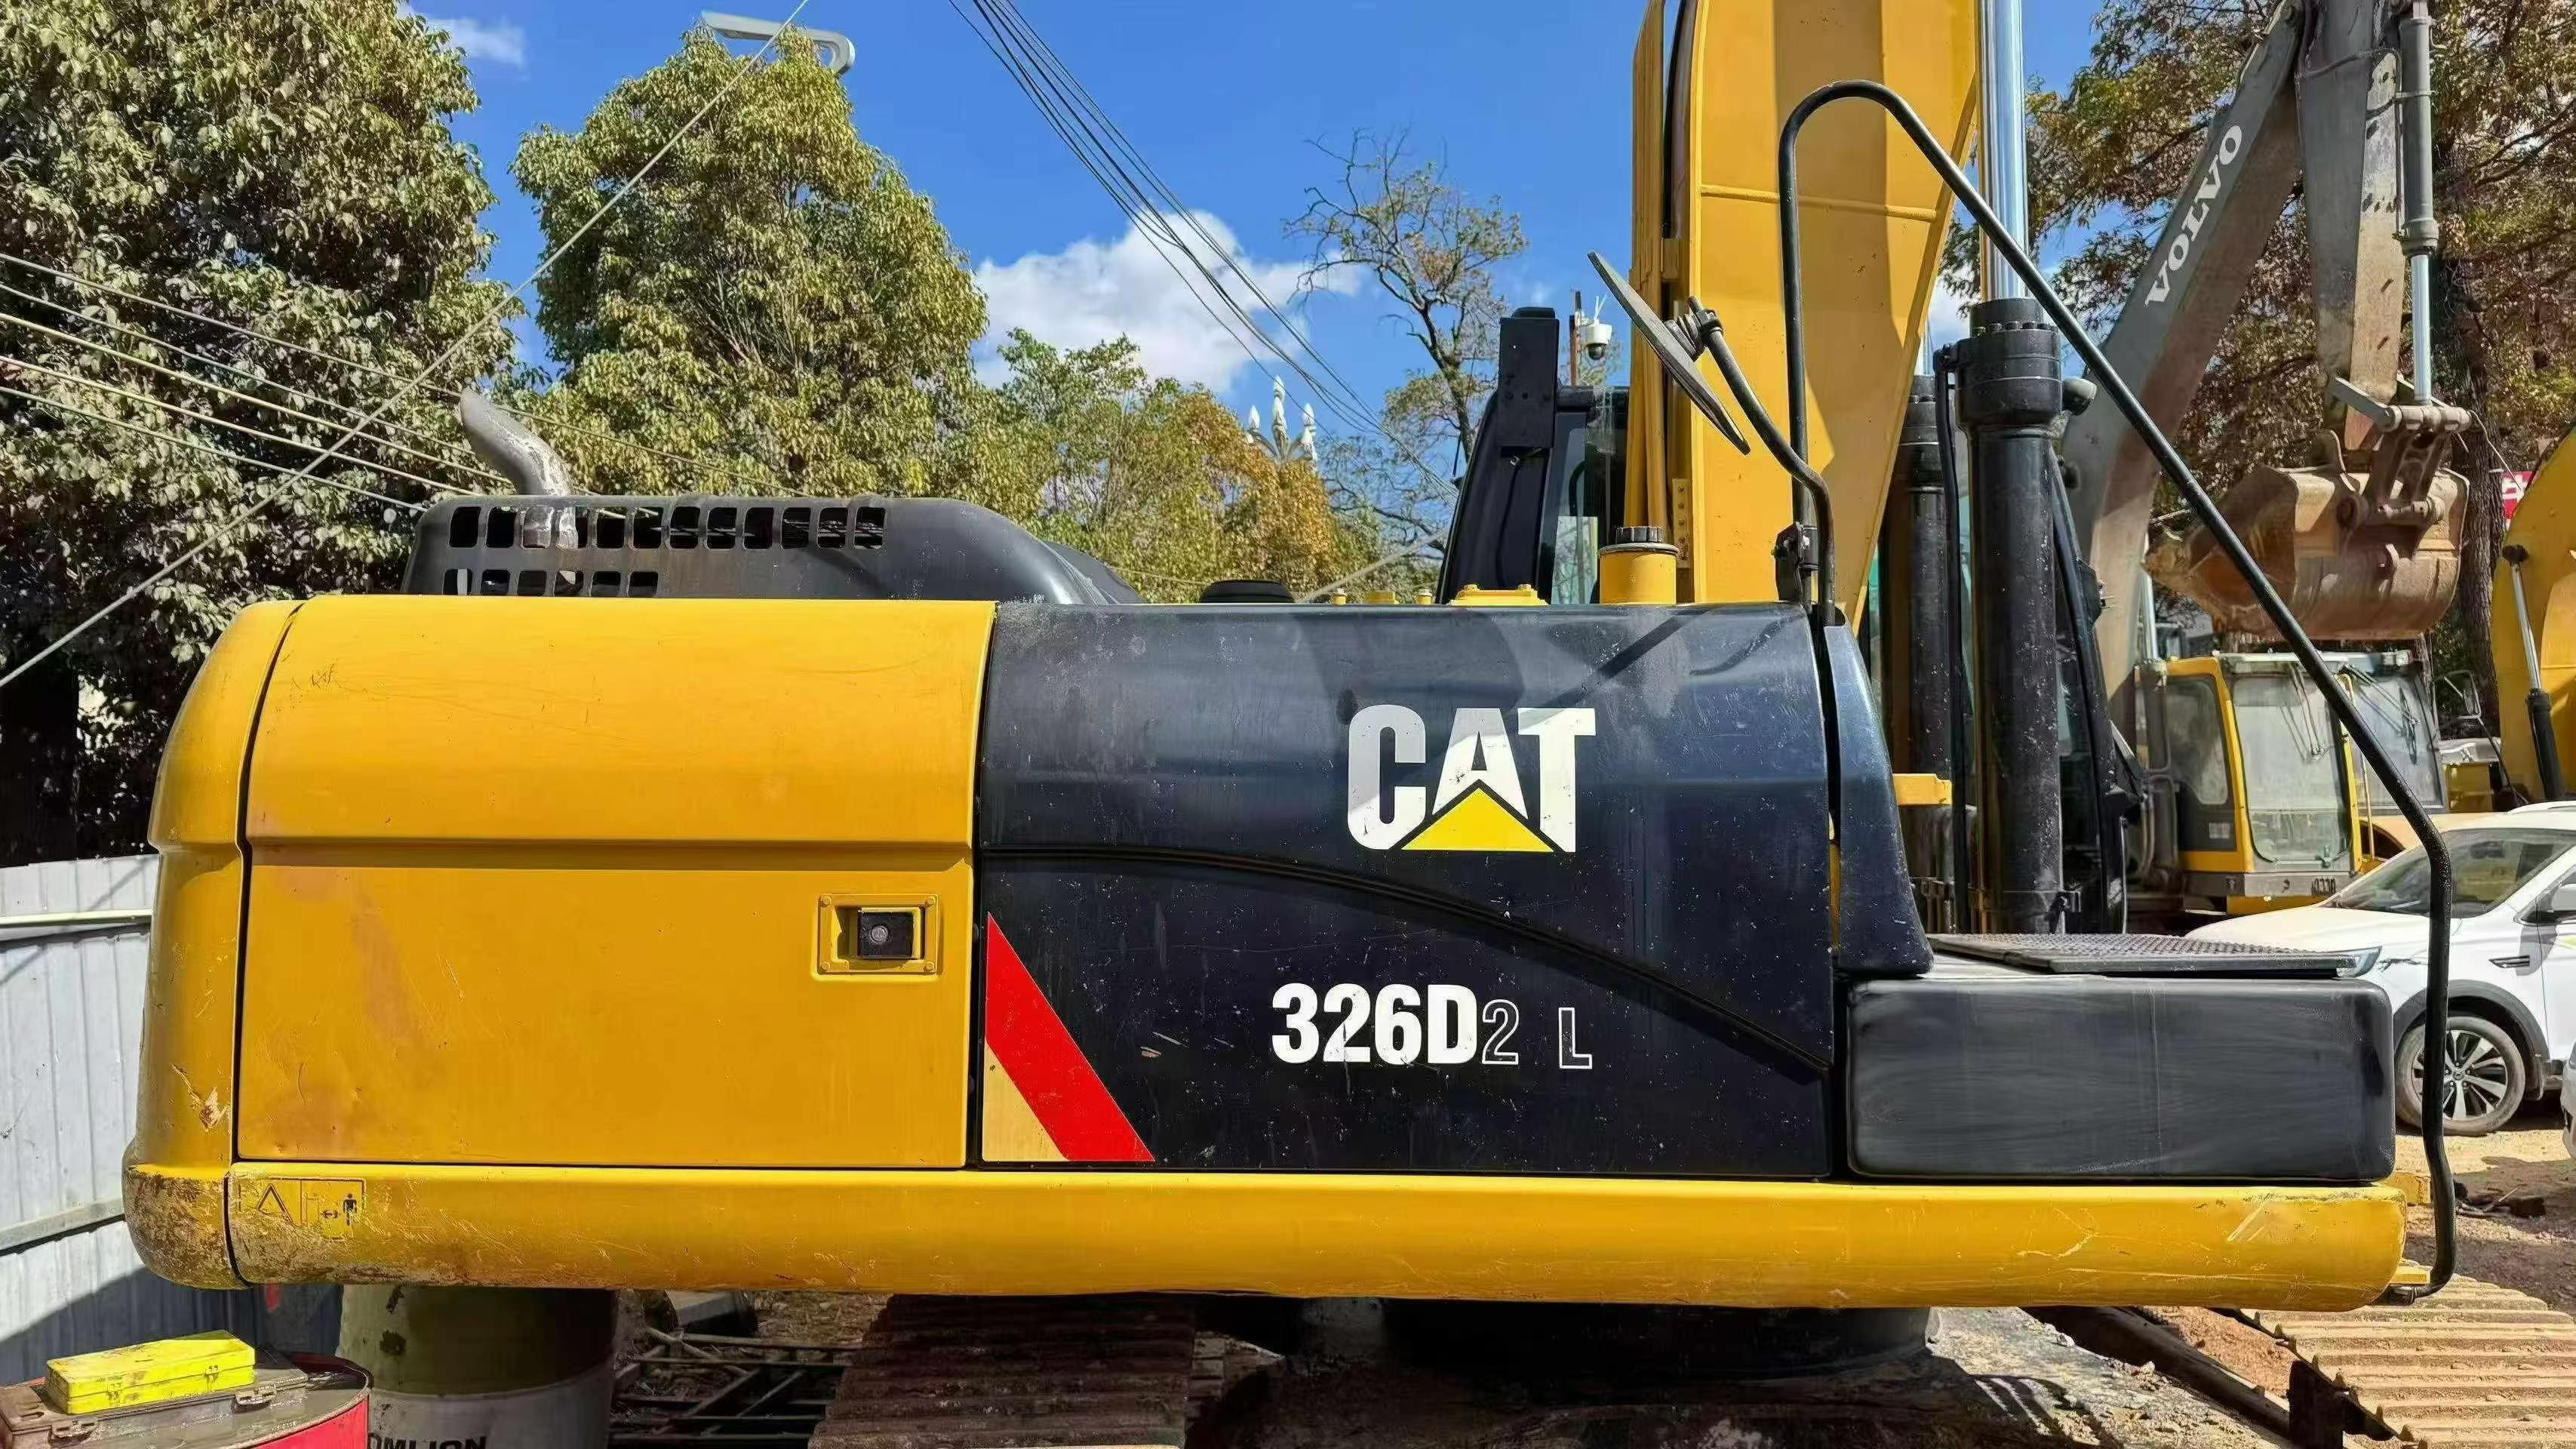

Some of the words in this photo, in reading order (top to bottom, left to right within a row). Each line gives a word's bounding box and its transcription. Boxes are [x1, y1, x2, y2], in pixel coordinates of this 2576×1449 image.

[2144, 125, 2242, 306] VOLVO
[1348, 704, 1596, 853] CAT
[1558, 1007, 1593, 1069] L
